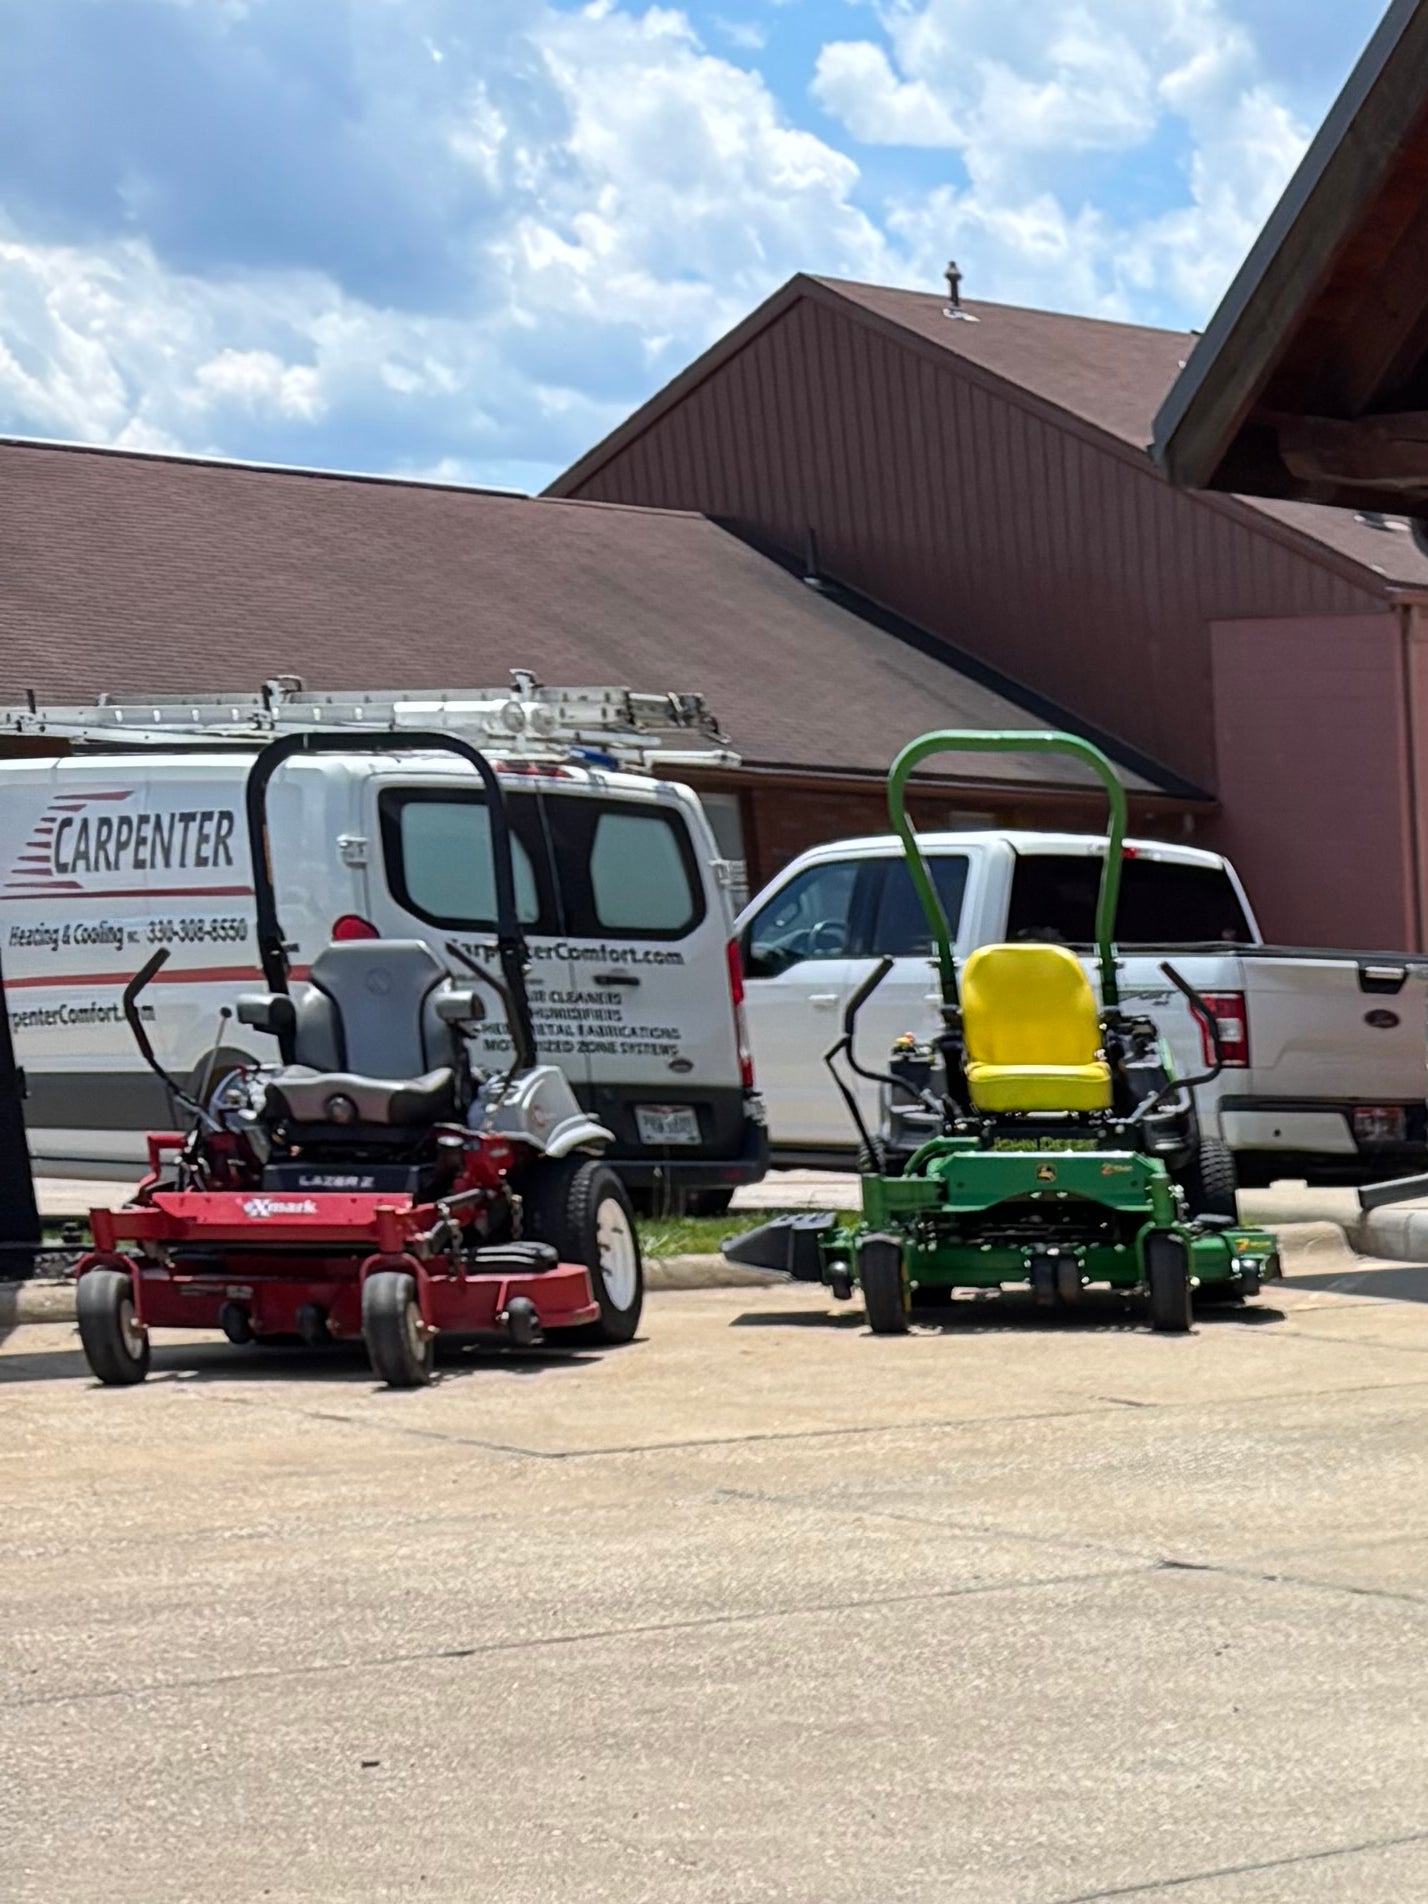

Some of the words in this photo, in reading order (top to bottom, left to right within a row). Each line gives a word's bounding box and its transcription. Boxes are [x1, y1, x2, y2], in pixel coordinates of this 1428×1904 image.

[53, 810, 236, 874] CARPENTER
[9, 922, 60, 951] Heating
[61, 924, 71, 945] &
[73, 920, 124, 950] Cooling
[146, 917, 248, 944] 330-308-8550
